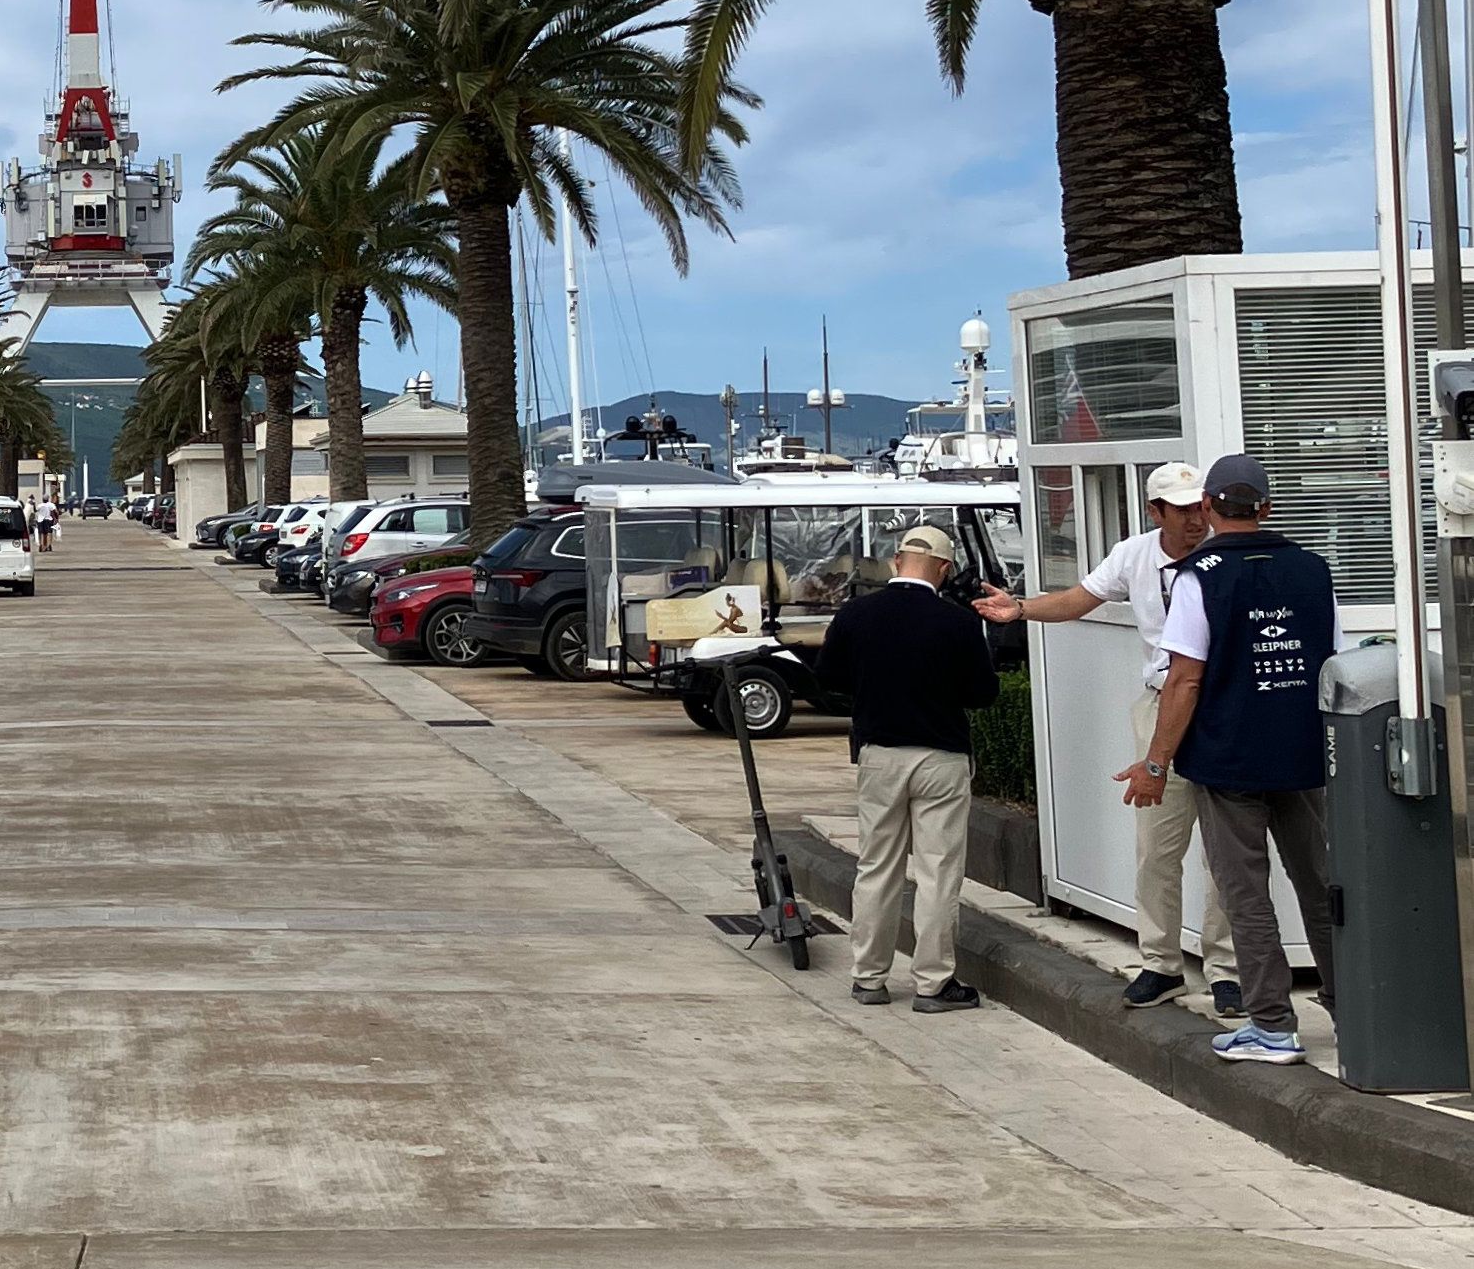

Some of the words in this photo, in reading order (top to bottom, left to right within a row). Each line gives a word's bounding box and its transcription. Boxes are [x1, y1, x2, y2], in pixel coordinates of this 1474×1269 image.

[1253, 640, 1302, 652] SLEIPNER
[1254, 658, 1303, 667] VOLVO
[1255, 665, 1305, 674] PENTA
